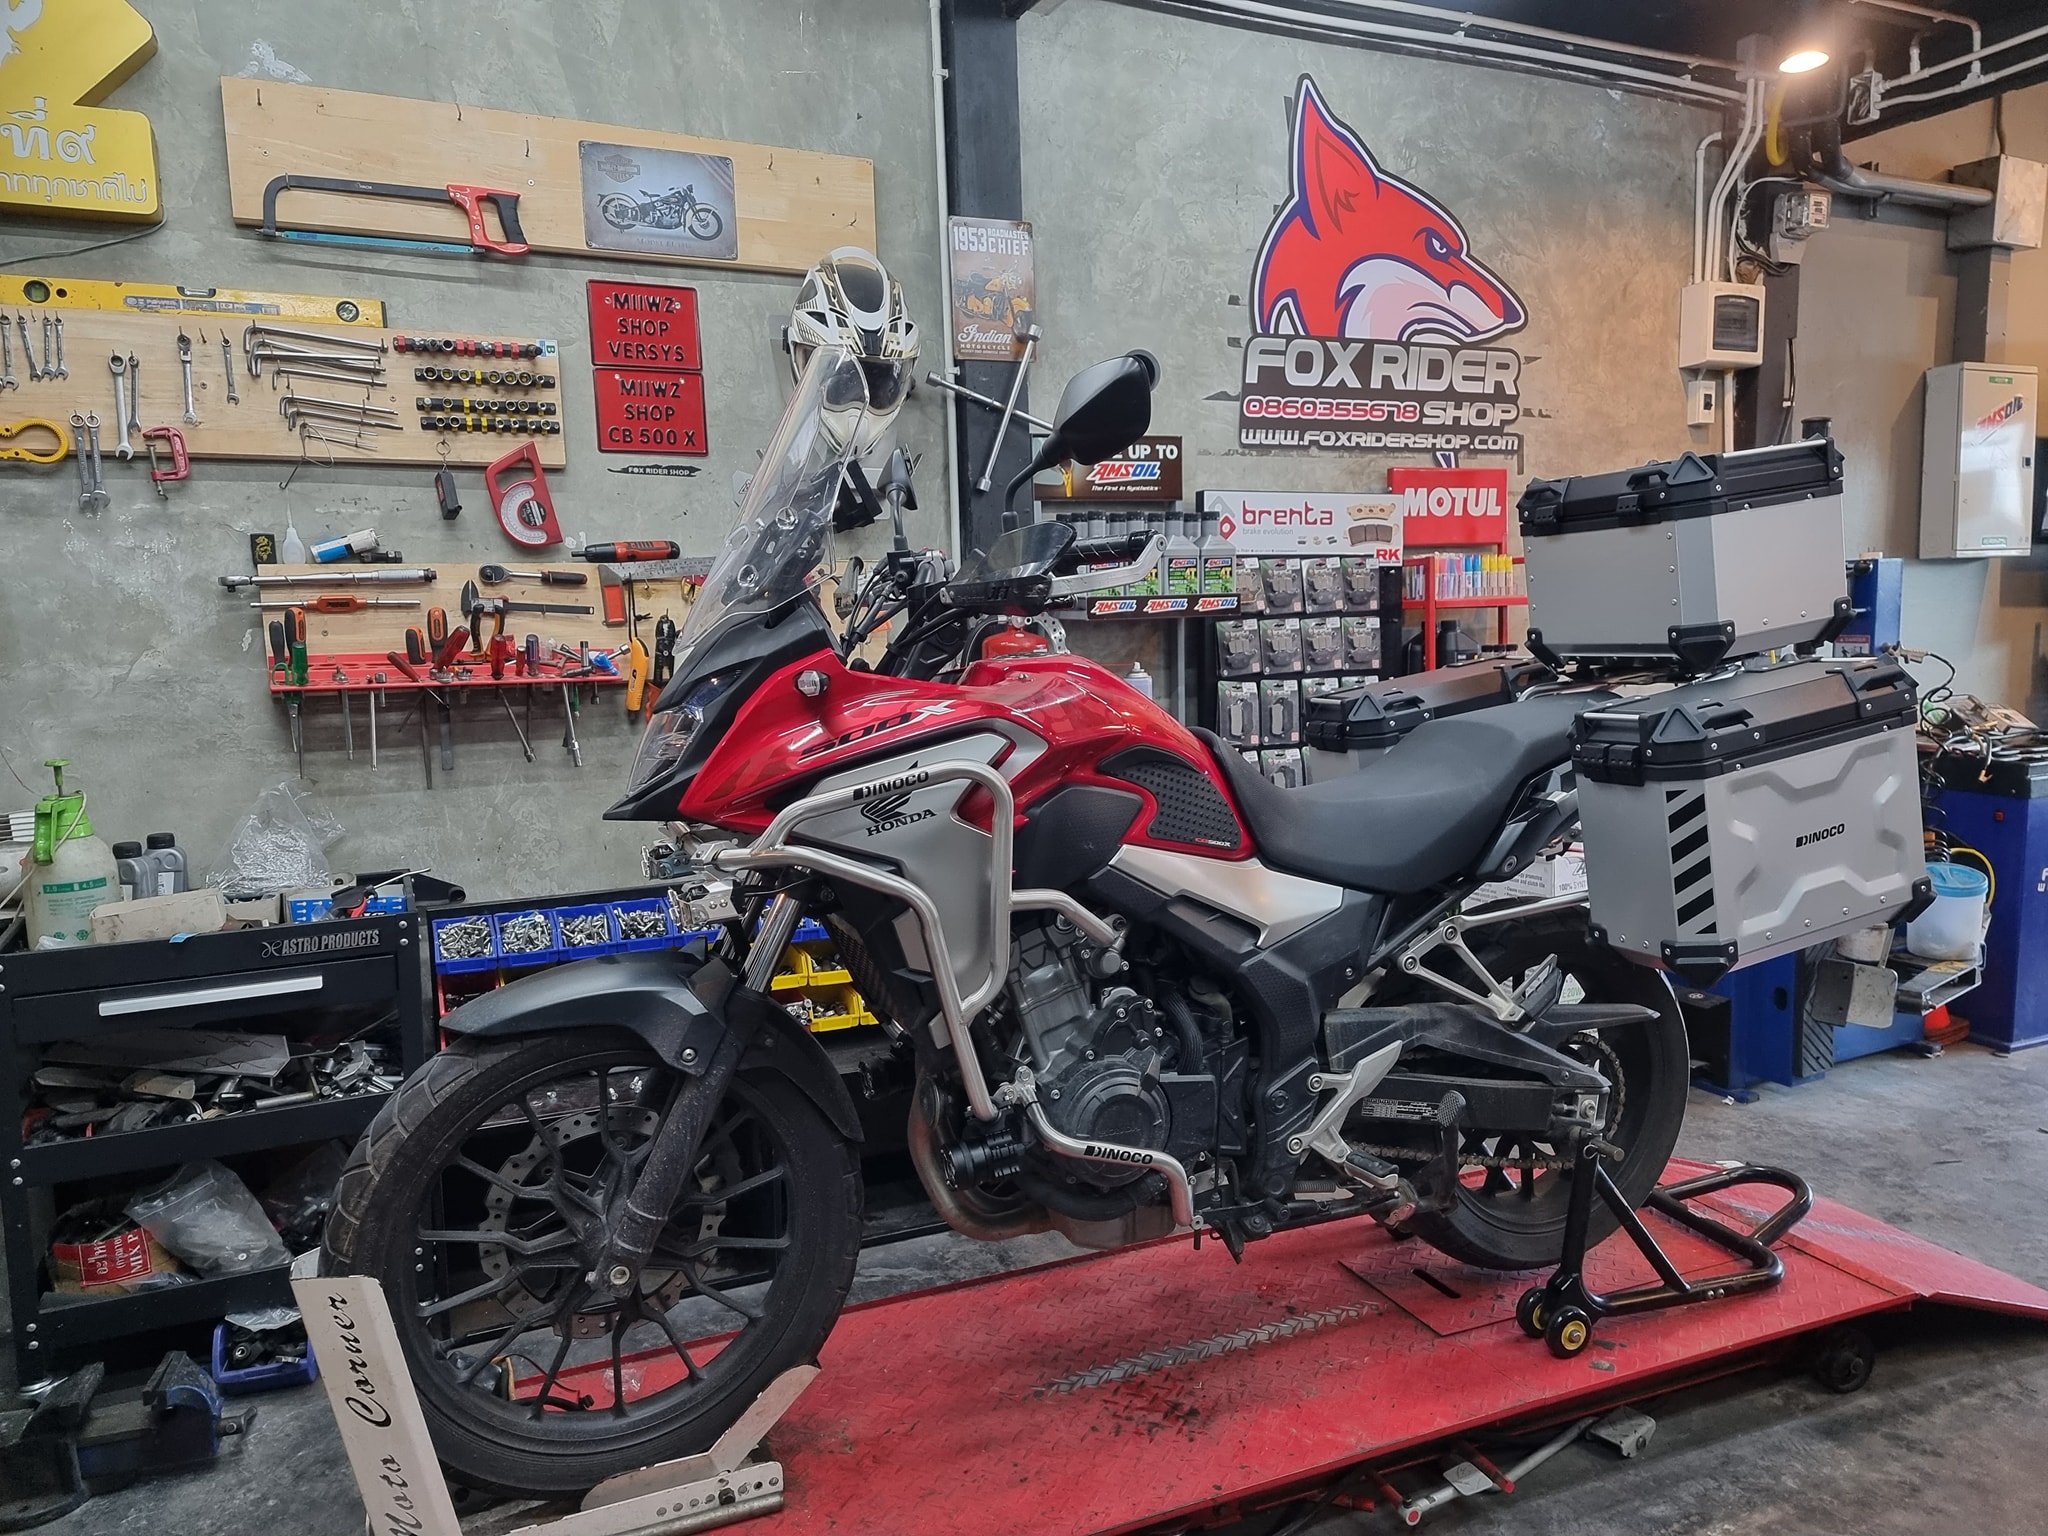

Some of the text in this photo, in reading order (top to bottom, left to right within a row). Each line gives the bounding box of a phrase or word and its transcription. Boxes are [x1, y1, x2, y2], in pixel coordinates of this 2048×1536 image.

[954, 226, 987, 252] 1953
[988, 238, 1029, 255] CHIEF
[613, 292, 676, 314] MIIWZ
[618, 318, 670, 336] SHOP
[958, 324, 1012, 344] Indian
[608, 341, 685, 362] VERSYS
[1245, 337, 1519, 395] FOX RIDER
[620, 379, 681, 398] MIIWZ
[625, 404, 676, 421] SHOP
[1244, 396, 1519, 427] 0860355678 SHOP
[608, 427, 696, 446] CB 500 X
[1128, 444, 1178, 459] UP TO
[628, 466, 690, 476] FOX RIDER SHOP
[1088, 462, 1160, 482] AMSOIL
[1403, 487, 1502, 517] MOTUL
[1242, 499, 1334, 527] brenta
[1242, 527, 1294, 536] brake evolution
[1375, 548, 1400, 561] RK
[1092, 600, 1136, 614] AMSOIL
[1144, 599, 1188, 613] AMSOIL
[1195, 597, 1238, 611] AMSOIL
[853, 771, 929, 801] DINOCO
[866, 808, 937, 837] HONDA
[1795, 823, 1845, 848] DINOCO
[282, 930, 380, 956] ASTRO PRODUCTS
[1084, 1145, 1154, 1165] DINOCO
[129, 1244, 143, 1274] MIX
[328, 1292, 392, 1428] Corner
